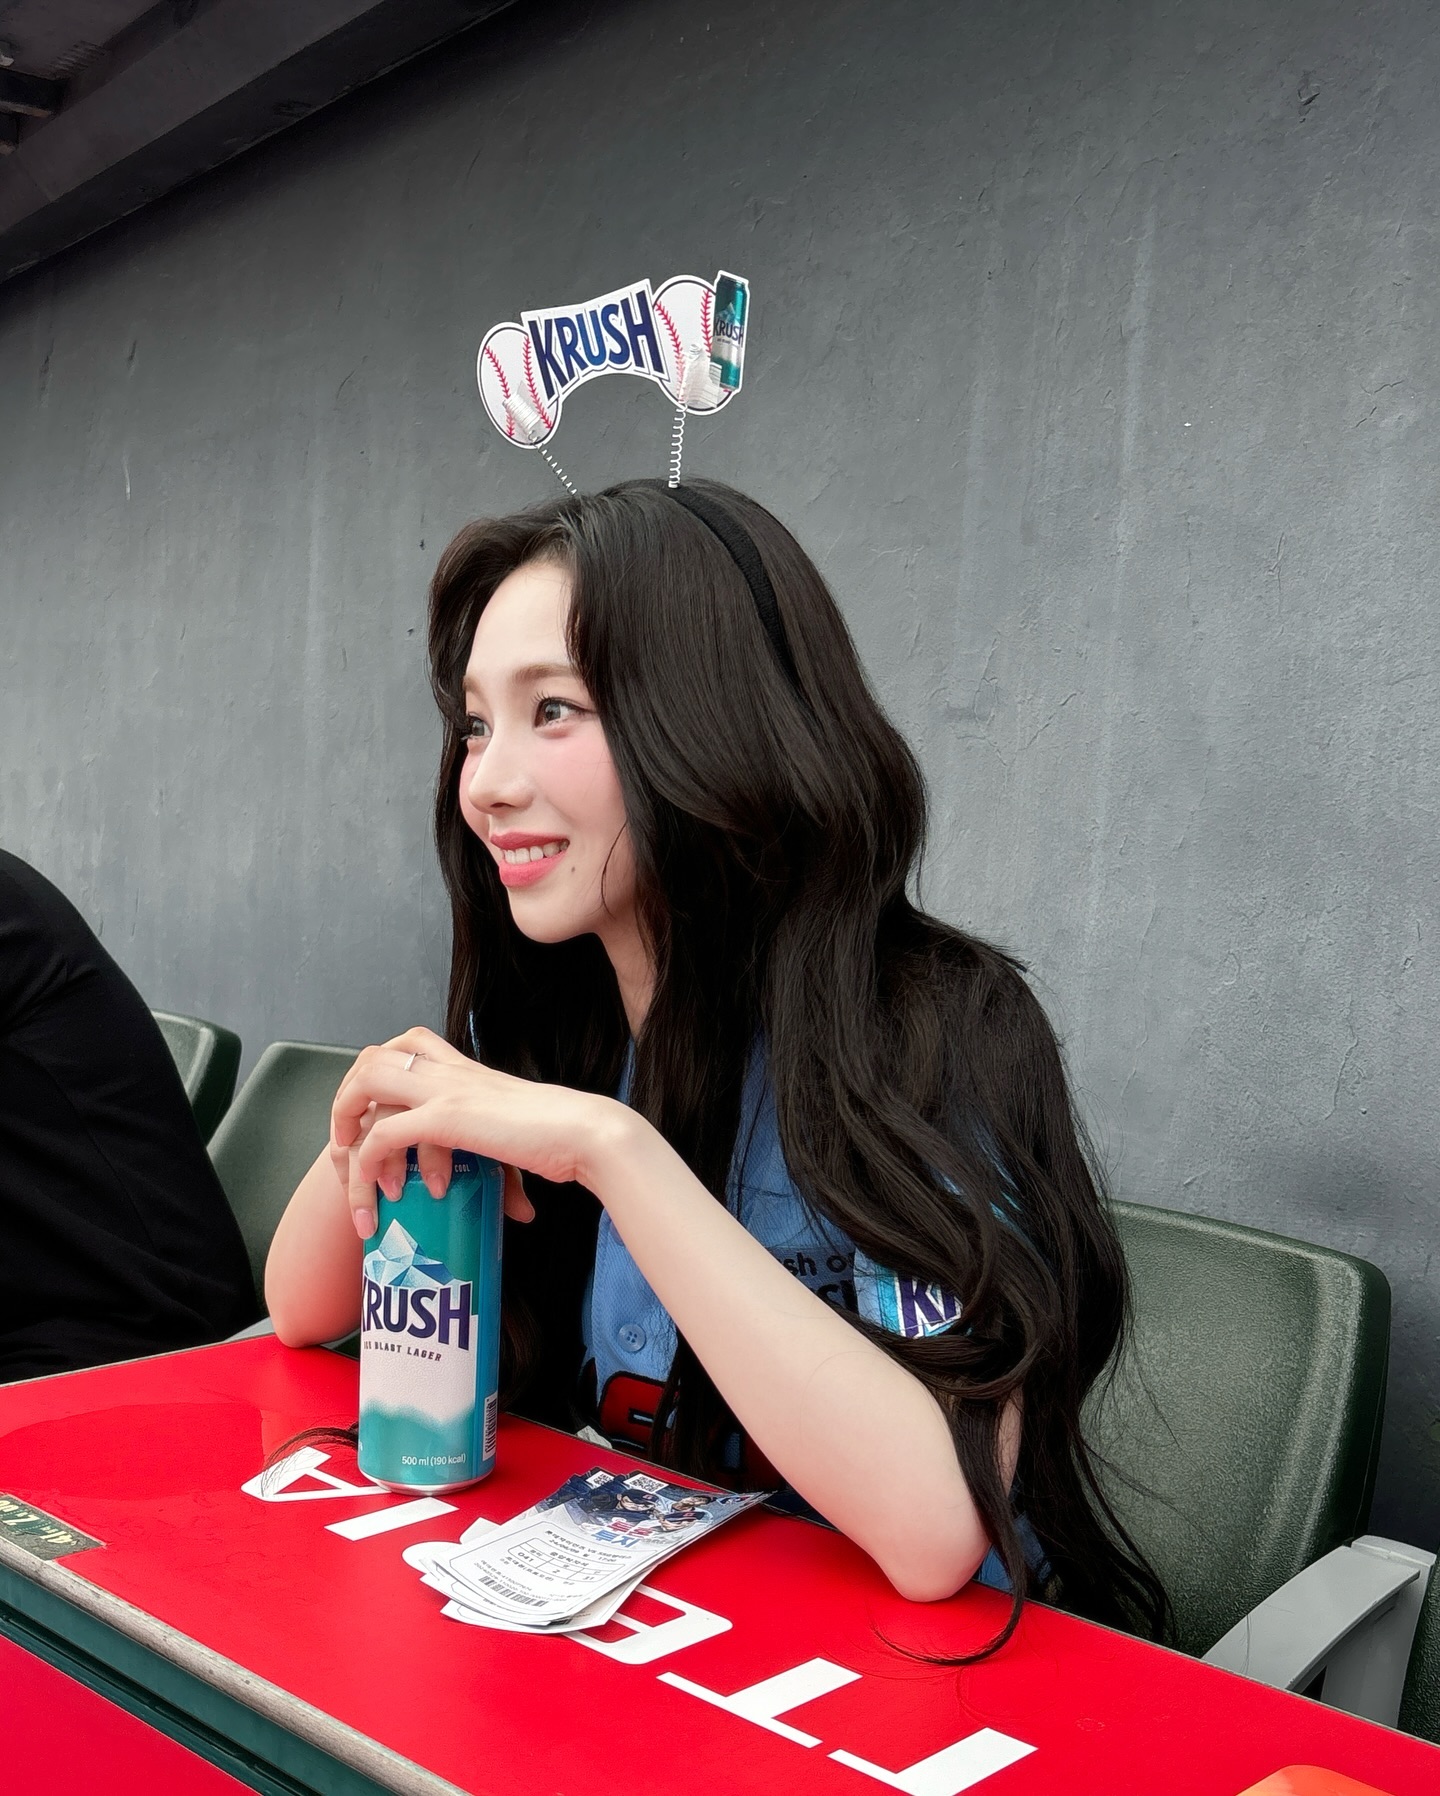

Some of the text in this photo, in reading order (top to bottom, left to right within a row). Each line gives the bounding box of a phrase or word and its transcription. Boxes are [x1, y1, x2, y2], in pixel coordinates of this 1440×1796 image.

[528, 290, 664, 400] KRUSH
[713, 318, 744, 348] KRUSH
[375, 1341, 402, 1353] BLAST
[407, 1346, 442, 1361] LAGER
[402, 1453, 466, 1467] 500 ml (190 kcal)
